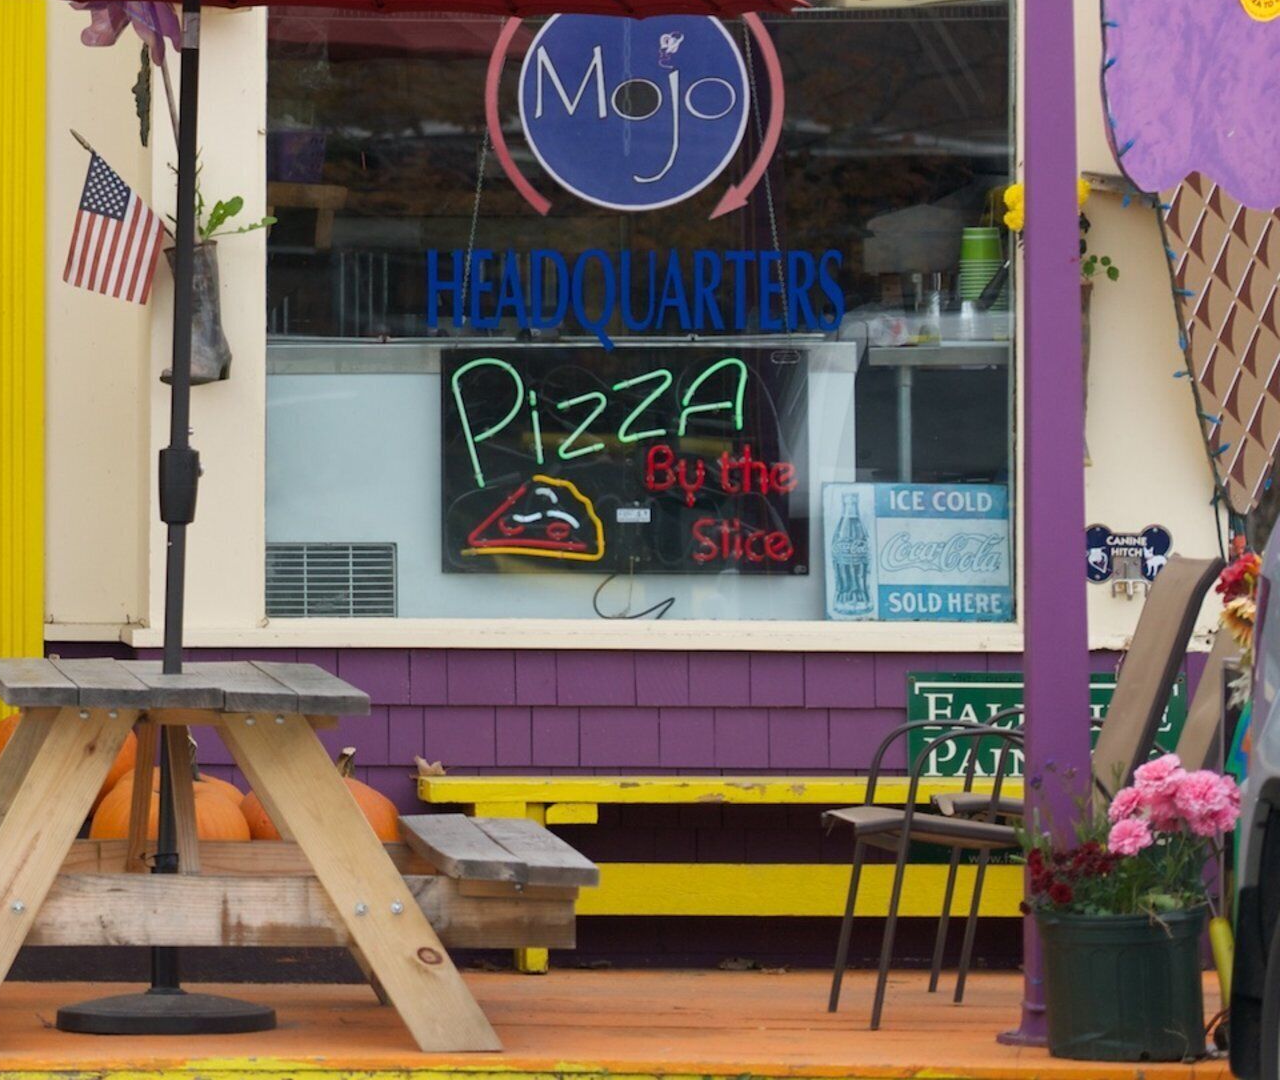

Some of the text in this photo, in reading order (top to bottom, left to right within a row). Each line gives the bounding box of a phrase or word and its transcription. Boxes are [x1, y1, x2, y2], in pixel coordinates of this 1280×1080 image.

[534, 30, 738, 184] Mojo
[426, 248, 846, 352] HEADQUARTERS
[646, 443, 798, 507] By the
[890, 490, 993, 512] ICE COLD
[691, 517, 795, 563] Slice
[880, 531, 1005, 573] Coca-Cola
[1106, 536, 1148, 546] CANINE
[1111, 547, 1144, 557] HITCH
[888, 592, 1003, 614] SOLD HERE
